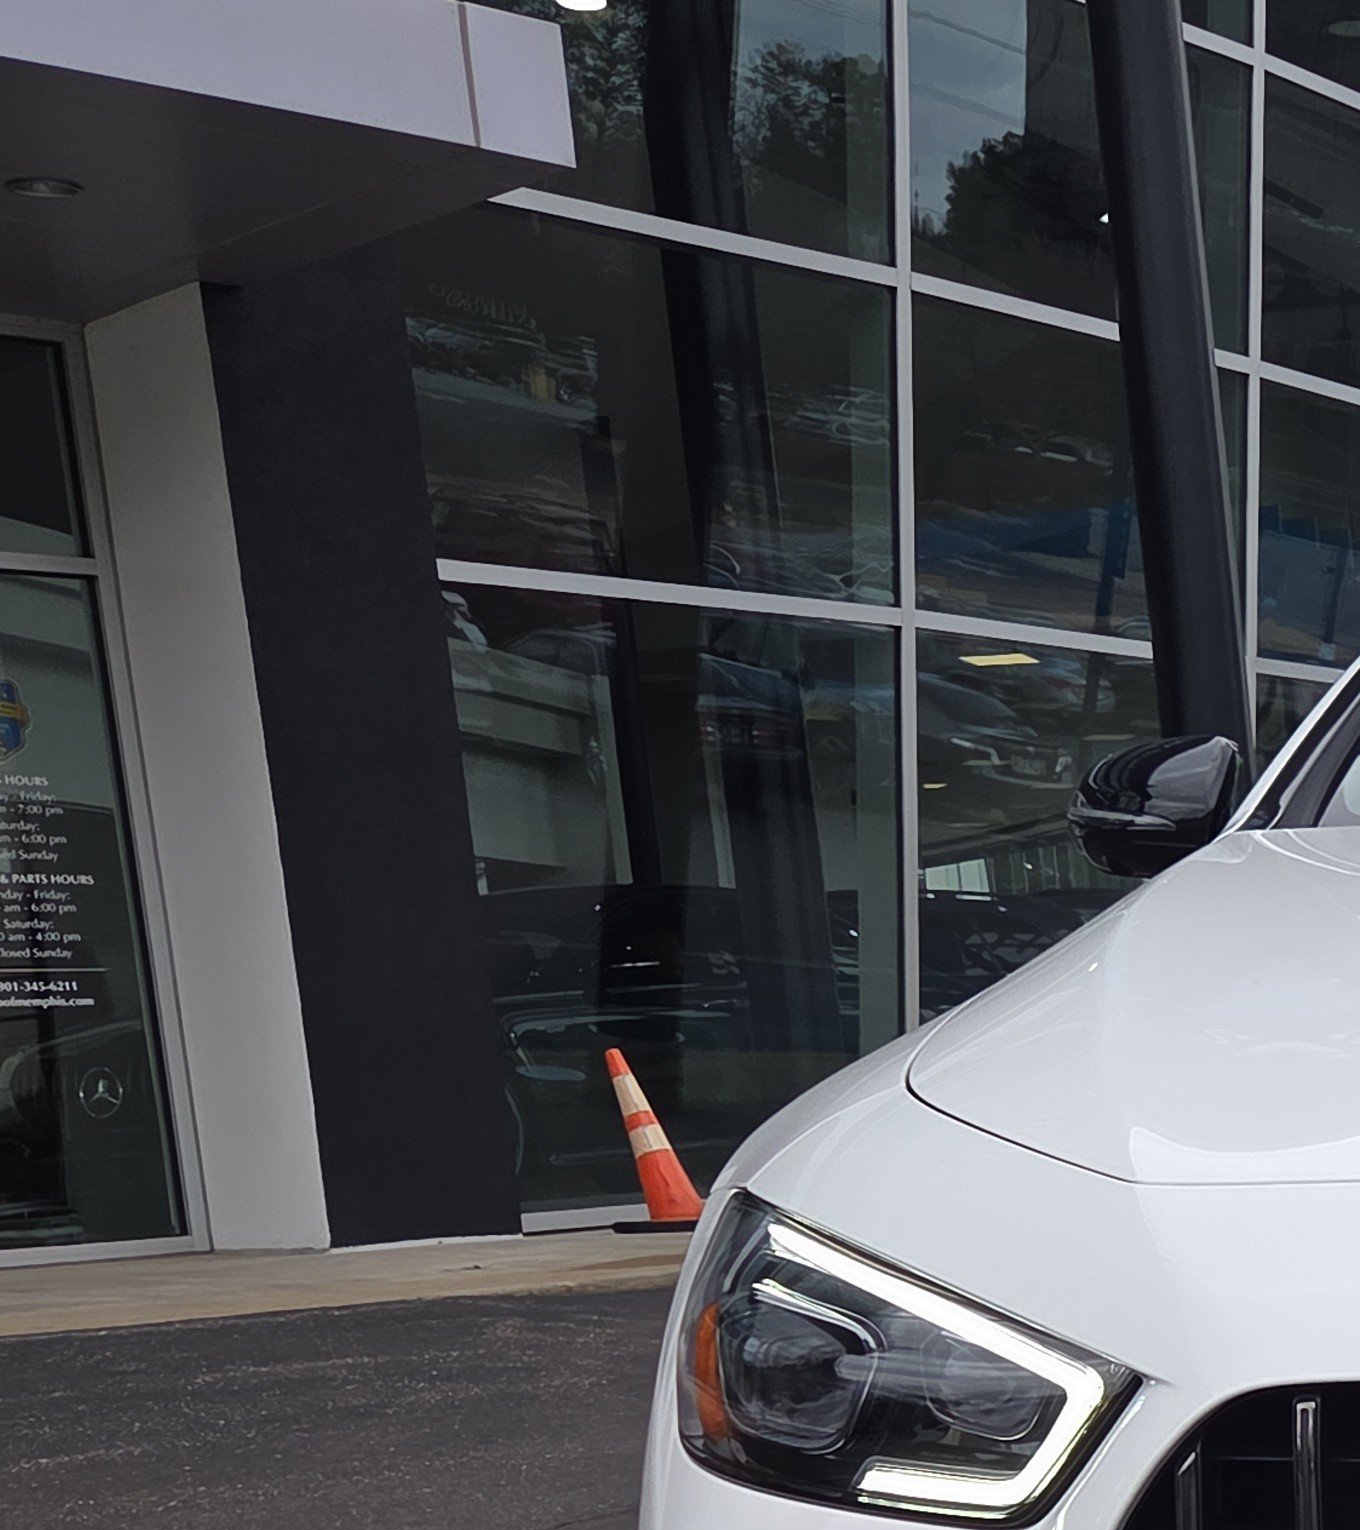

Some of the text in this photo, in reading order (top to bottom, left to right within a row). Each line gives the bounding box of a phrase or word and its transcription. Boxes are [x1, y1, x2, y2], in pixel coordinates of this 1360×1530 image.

[4, 775, 49, 786] HOURS
[11, 874, 48, 884] PARTS
[50, 874, 95, 885] HOURS
